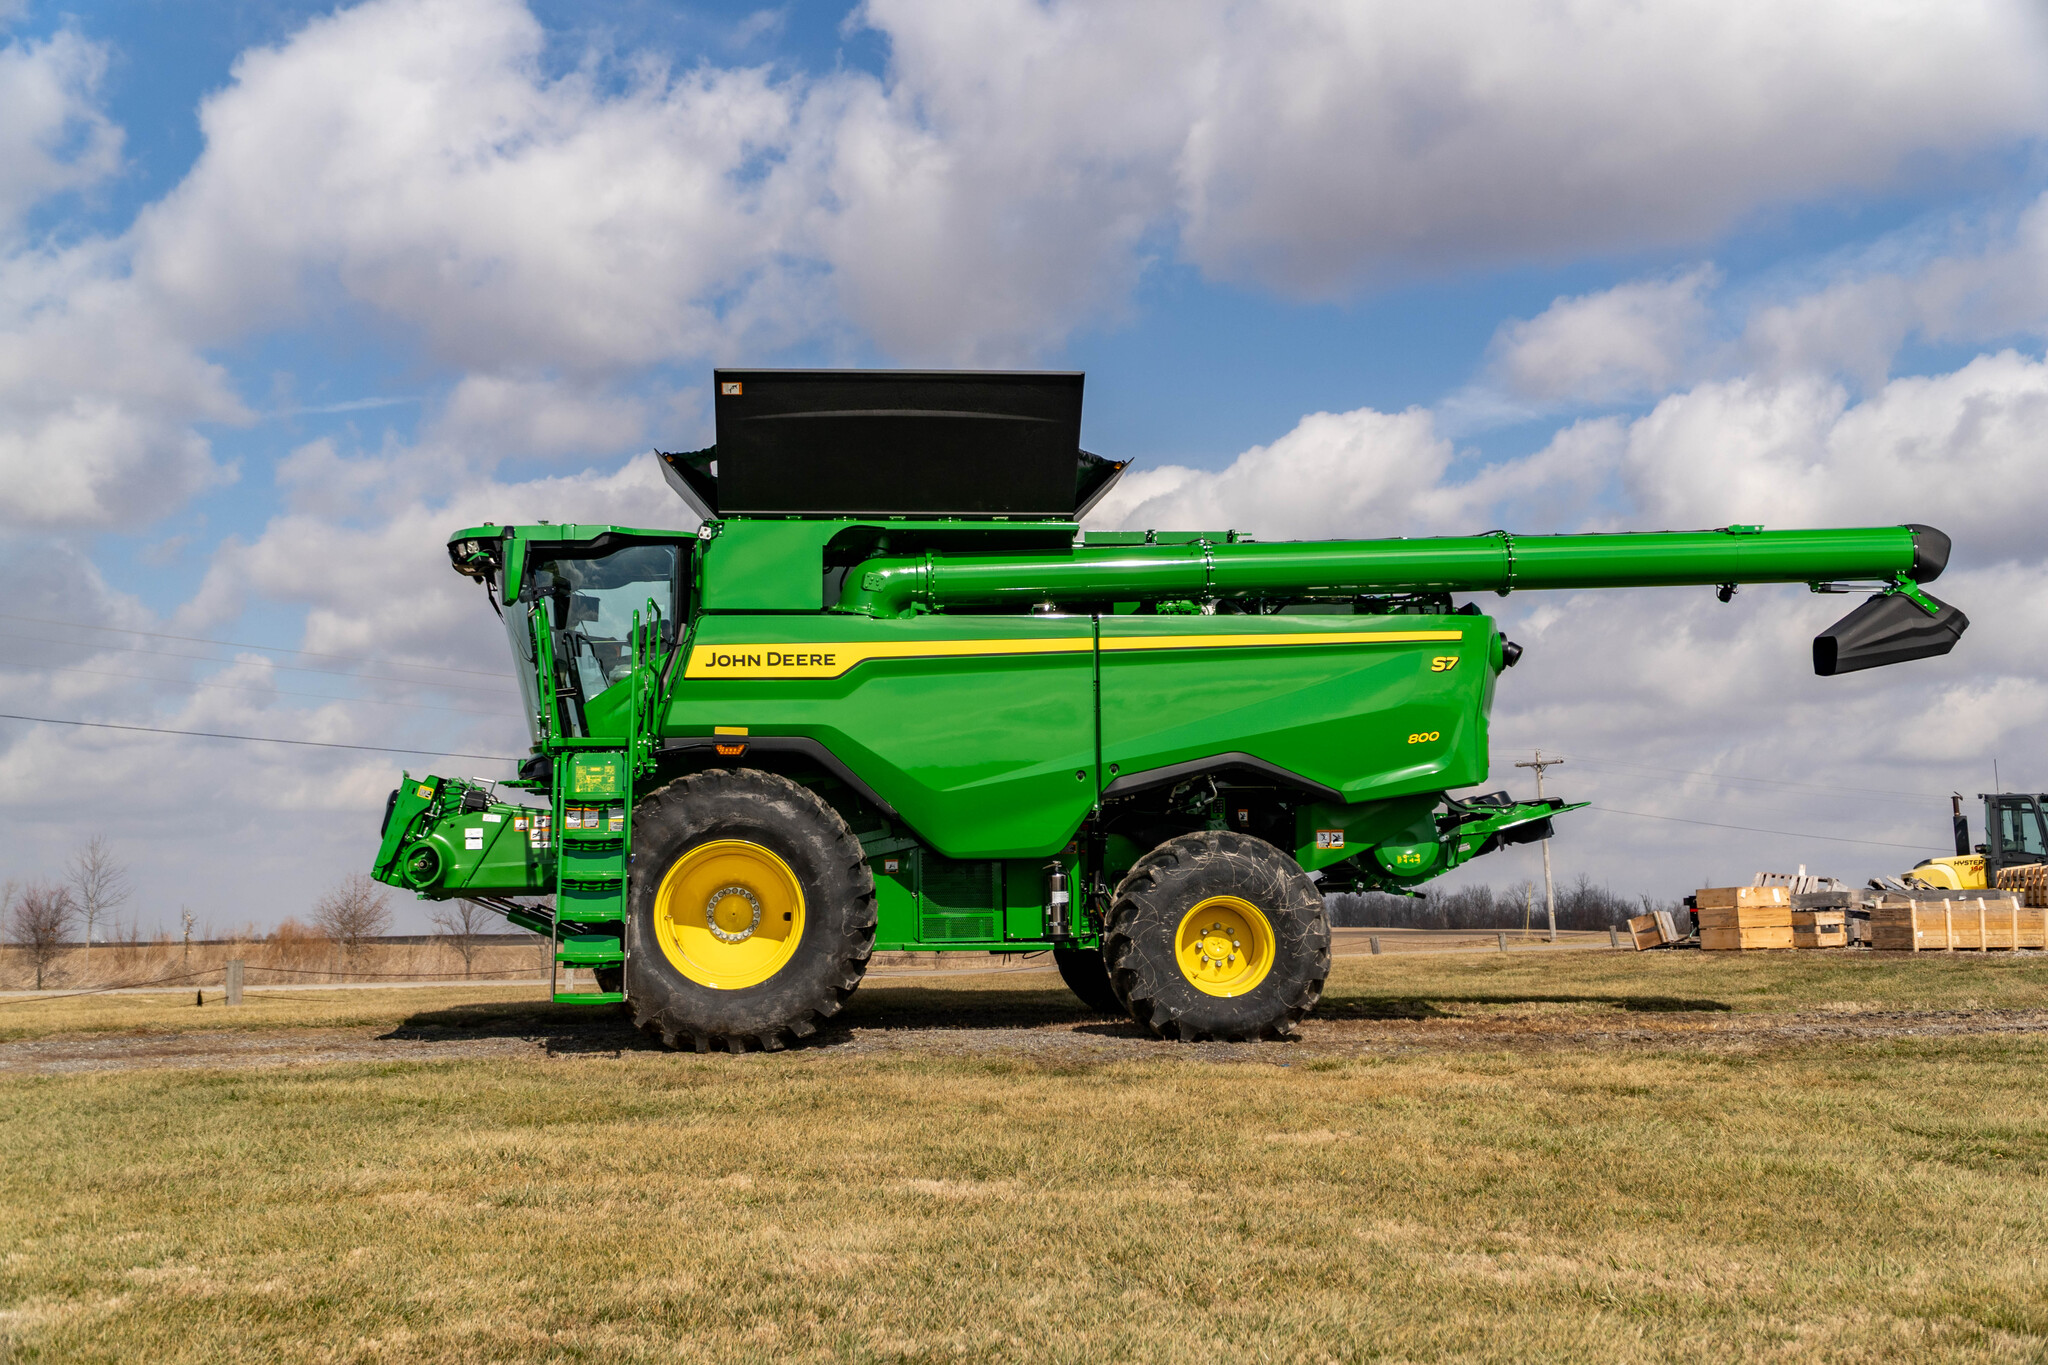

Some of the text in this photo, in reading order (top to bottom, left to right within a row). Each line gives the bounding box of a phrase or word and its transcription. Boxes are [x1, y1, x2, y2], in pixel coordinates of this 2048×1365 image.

[705, 652, 836, 667] JOHN DEERE
[1431, 656, 1460, 673] S7
[1407, 731, 1440, 744] 800
